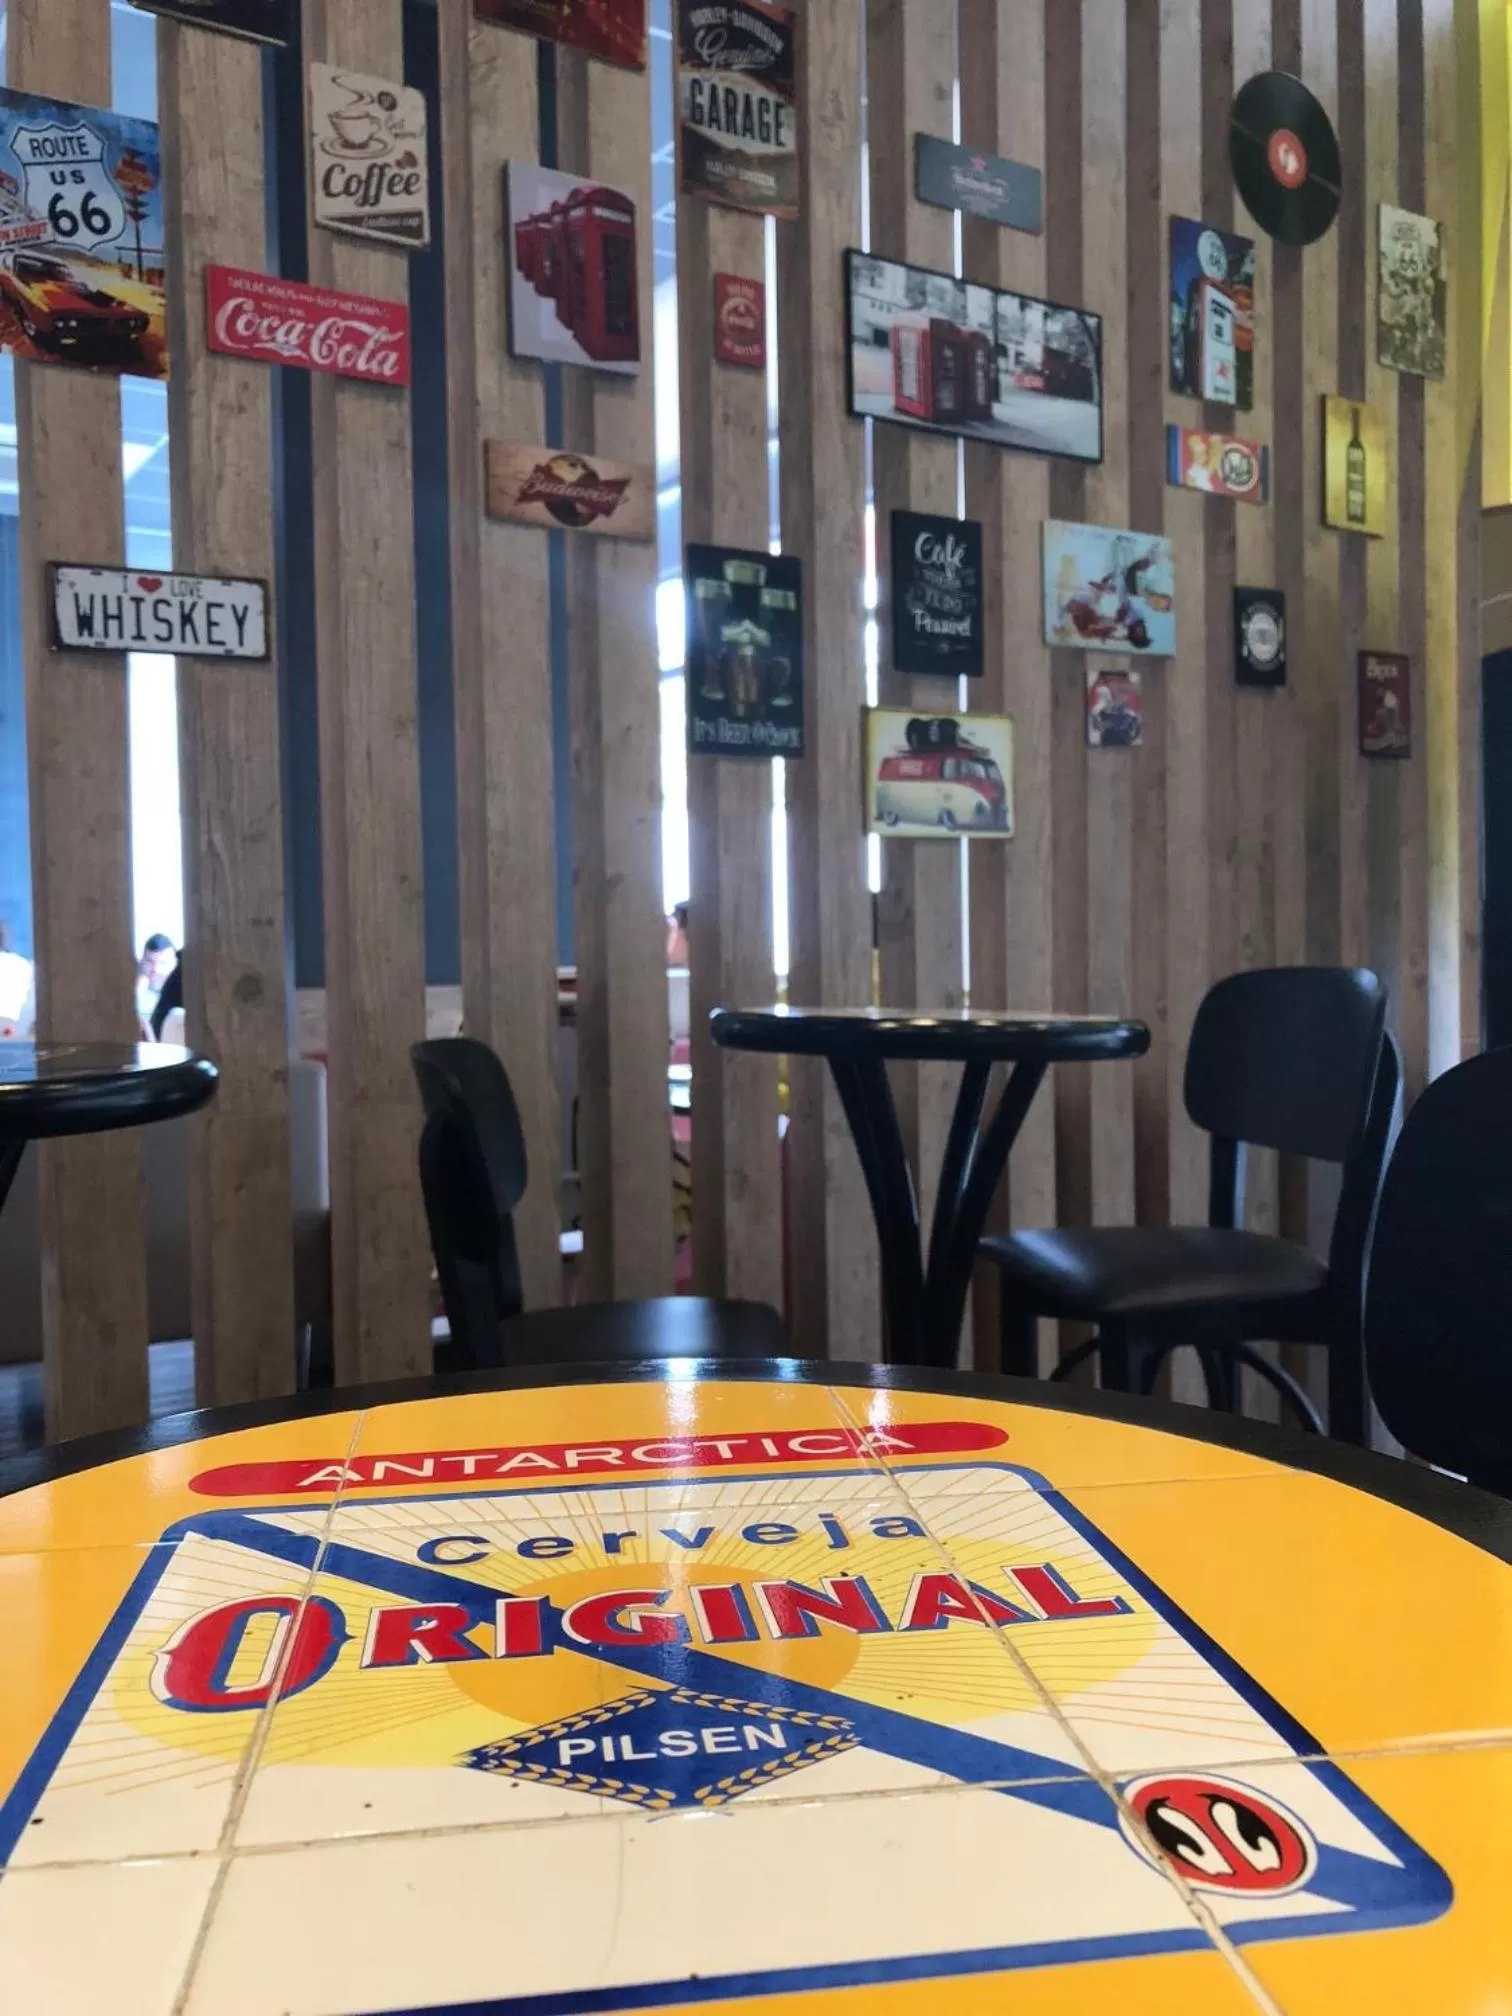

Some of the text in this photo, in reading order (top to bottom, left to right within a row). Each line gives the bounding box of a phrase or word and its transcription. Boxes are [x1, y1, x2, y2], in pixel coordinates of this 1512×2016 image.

[690, 78, 786, 147] GARAGE
[29, 135, 90, 158] ROUTE
[51, 168, 86, 186] US
[322, 162, 421, 207] Coffee
[48, 190, 111, 238] 66
[215, 296, 405, 377] Coca-Cola
[914, 531, 968, 580] Café
[122, 575, 204, 600] I LOVE
[73, 592, 249, 647] WHISKEY
[296, 1430, 917, 1487] ANTARCTICA
[416, 1512, 928, 1566] Cerveja
[151, 1562, 1137, 1713] ORIGINAL
[557, 1723, 790, 1766] PILSEN
